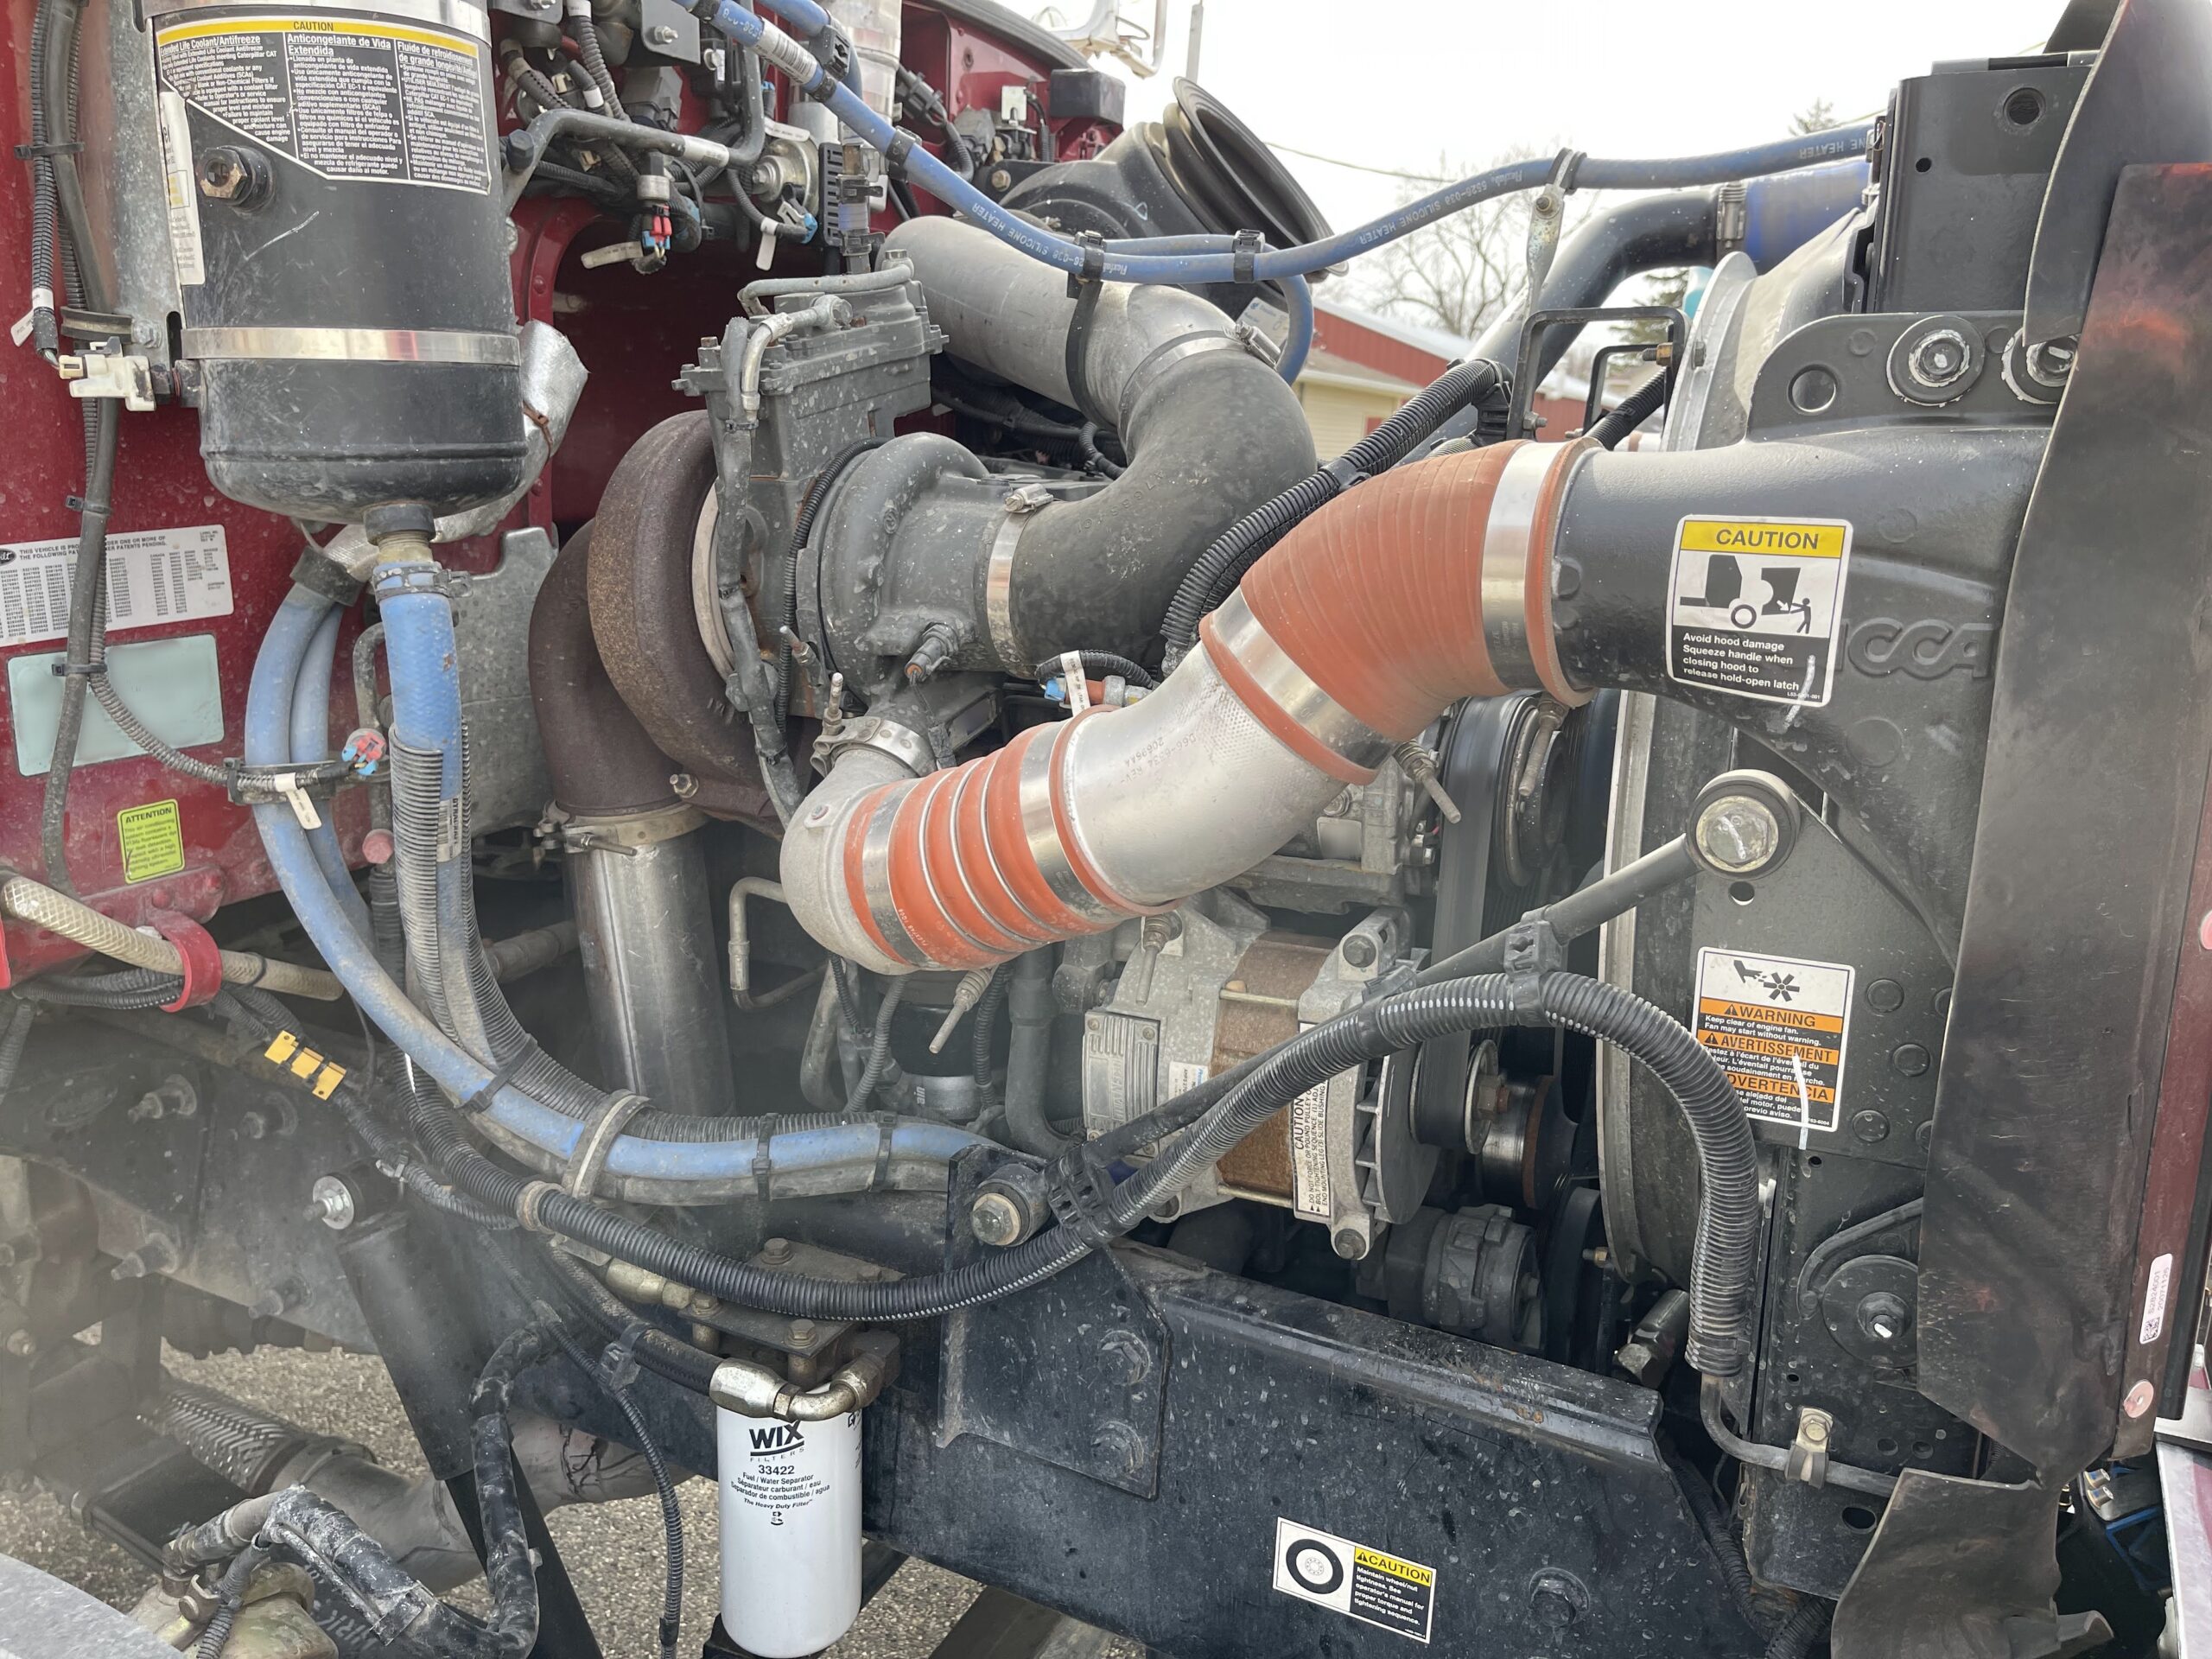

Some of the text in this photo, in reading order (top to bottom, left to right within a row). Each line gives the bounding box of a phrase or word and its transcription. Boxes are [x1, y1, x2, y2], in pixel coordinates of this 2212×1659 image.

[294, 21, 334, 31] CAUTION
[180, 41, 191, 50] Life
[192, 35, 260, 48] Coolant/Antifreeze
[287, 34, 391, 49] Anticongelante de Vida
[288, 45, 334, 54] Extendida
[397, 41, 420, 53] Fluide
[422, 46, 430, 55] de
[398, 54, 435, 67] de grande
[1799, 142, 1844, 159] HEATER
[972, 202, 1006, 232] HEATER
[1400, 200, 1441, 227] SILICONE
[1008, 228, 1049, 256] SILICONE
[1359, 222, 1396, 245] HEATER
[1716, 529, 1819, 550] CAUTION
[1683, 632, 1784, 652] Avoid hood damage
[1683, 645, 1793, 664] Squeeze handle when
[1683, 657, 1759, 673] closing hood to
[1683, 668, 1799, 691] release hold-open latch
[125, 806, 172, 823] ATTENTION
[1705, 1014, 1725, 1025] Keep
[1726, 1018, 1745, 1027] clear
[1757, 1022, 1783, 1033] engine
[1784, 1027, 1799, 1035] fan.
[1740, 1006, 1815, 1027] WARNING
[1720, 1026, 1737, 1034] may
[1738, 1027, 1756, 1036] start
[1758, 1030, 1787, 1040] without
[1788, 1035, 1821, 1046] warning.
[1720, 1036, 1832, 1062] AVERTISSEMENT
[1730, 1048, 1735, 1057] à
[1736, 1050, 1759, 1061] l'écart
[1808, 1061, 1819, 1070] du
[1732, 1058, 1769, 1070] L'éventail
[1726, 1064, 1781, 1079] soudainement
[1727, 1073, 1828, 1101] DVERTENCIA
[1745, 1090, 1773, 1102] alejado
[1775, 1095, 1787, 1103] del
[1769, 1109, 1792, 1119] aviso.
[1777, 1103, 1801, 1114] puede
[1294, 1098, 1304, 1149] CAUTION
[1306, 1149, 1311, 1158] OR
[1319, 1160, 1328, 1192] MOUNTING
[1309, 1194, 1314, 1203] DO
[749, 1420, 804, 1449] WIX
[750, 1447, 804, 1462] FILTERS
[743, 1471, 755, 1482] Fuel
[760, 1477, 779, 1485] Water
[781, 1474, 814, 1485] Separator
[758, 1465, 795, 1476] 33422
[731, 1481, 758, 1498] Separador
[769, 1490, 810, 1501] combustible
[815, 1484, 830, 1495] agua
[737, 1477, 769, 1492] Séparateur
[771, 1484, 804, 1493] carburant
[809, 1480, 822, 1489] eau
[755, 1501, 774, 1510] Heavy
[1357, 1566, 1418, 1592] Maintain wheel/nut
[1369, 1555, 1430, 1584] CAUTION
[1357, 1574, 1402, 1594] tightness. See
[1355, 1591, 1376, 1602] proper
[1377, 1598, 1399, 1610] torque
[1356, 1583, 1389, 1598] operator's
[1389, 1594, 1414, 1606] manual
[1354, 1598, 1421, 1625] tightening sequence.
